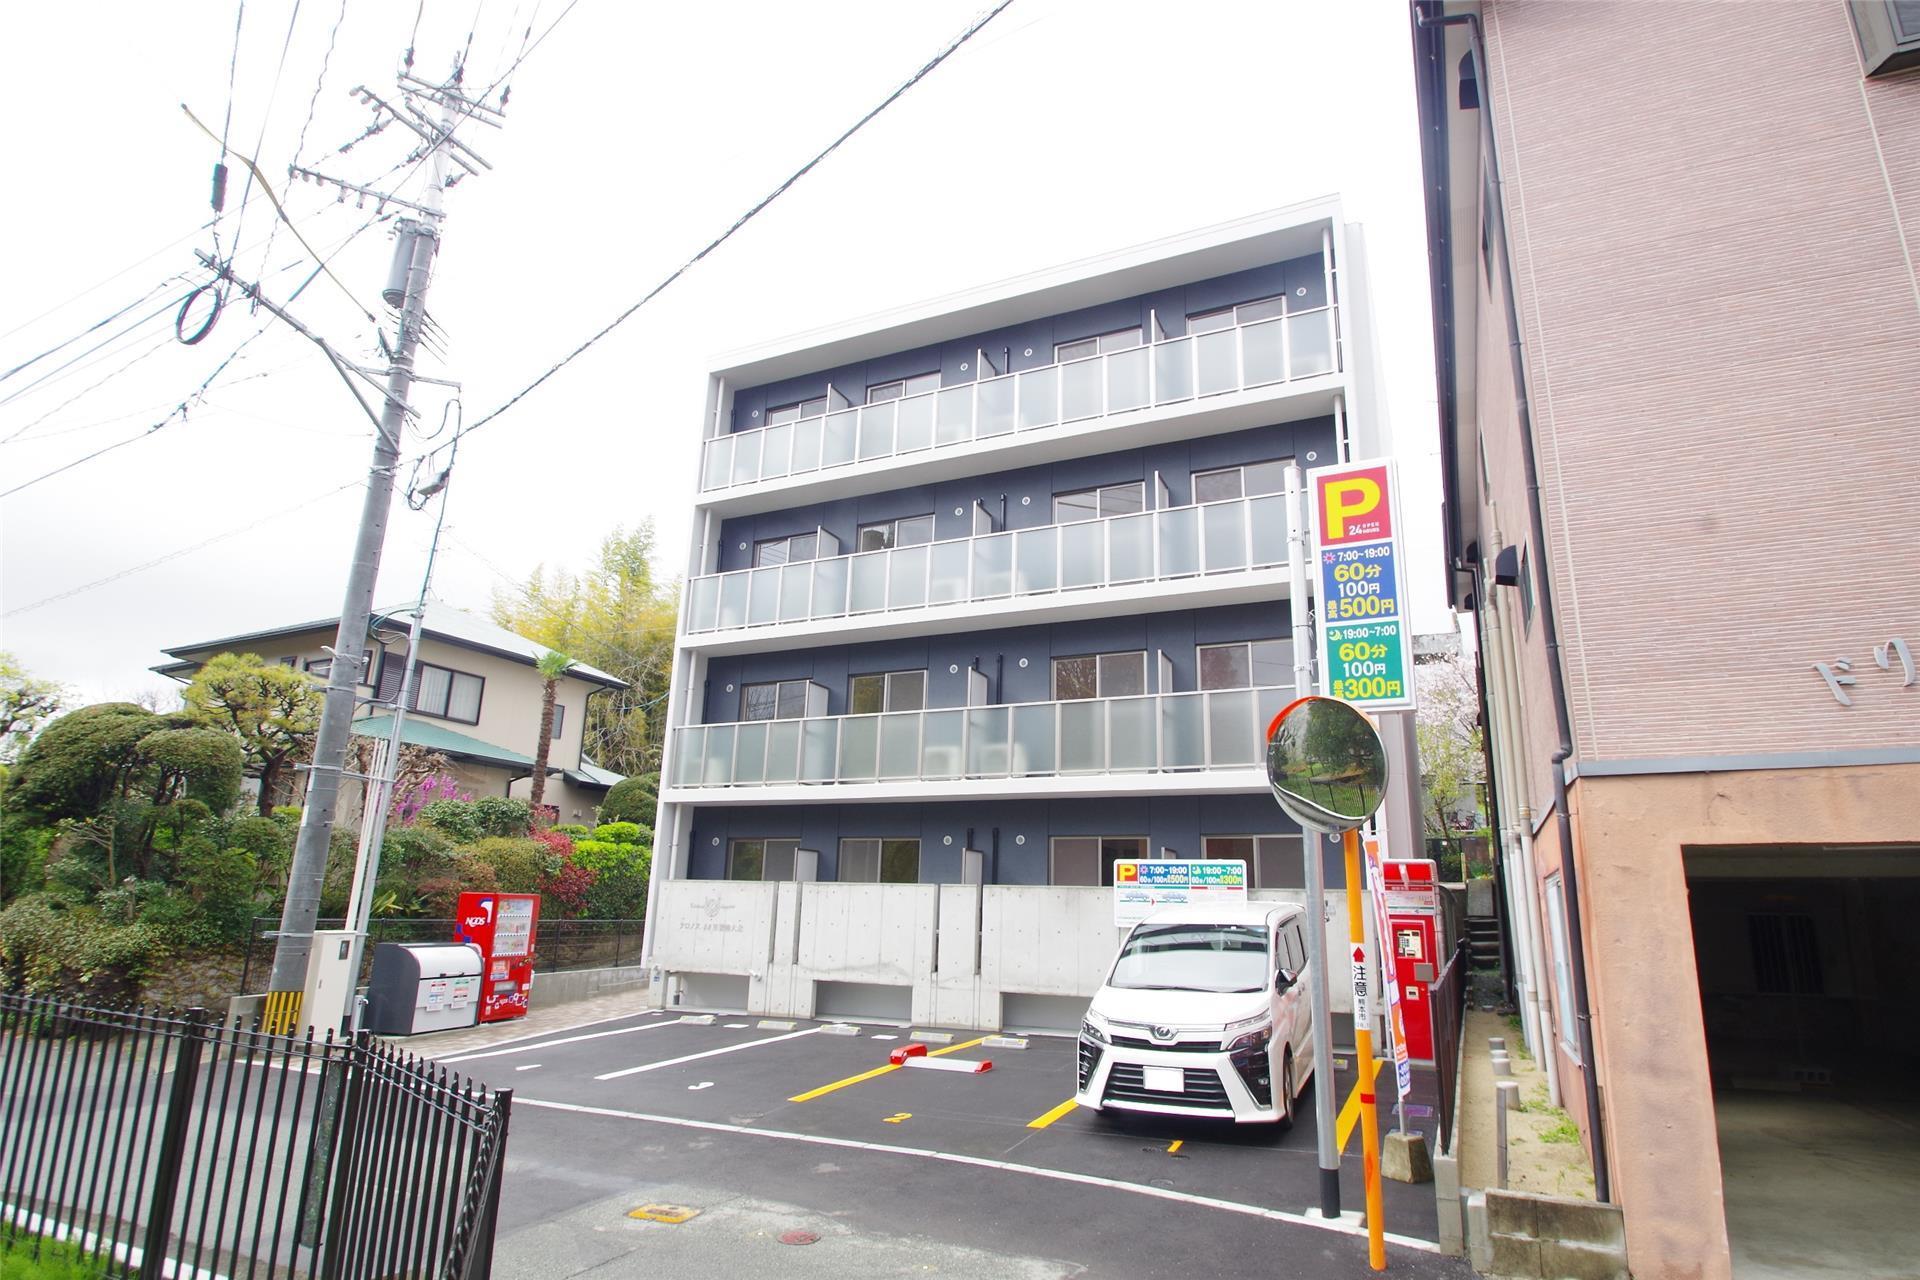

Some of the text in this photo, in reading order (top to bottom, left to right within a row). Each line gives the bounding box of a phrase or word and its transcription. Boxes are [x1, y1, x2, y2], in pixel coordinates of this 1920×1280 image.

[1324, 477, 1382, 540] P
[1348, 524, 1362, 536] 24
[1334, 562, 1382, 582] 60分
[1338, 581, 1380, 598] 100円
[1339, 641, 1388, 662] 60分
[1343, 661, 1386, 678] 100円
[1119, 865, 1136, 881] P
[1353, 965, 1368, 997] 注意
